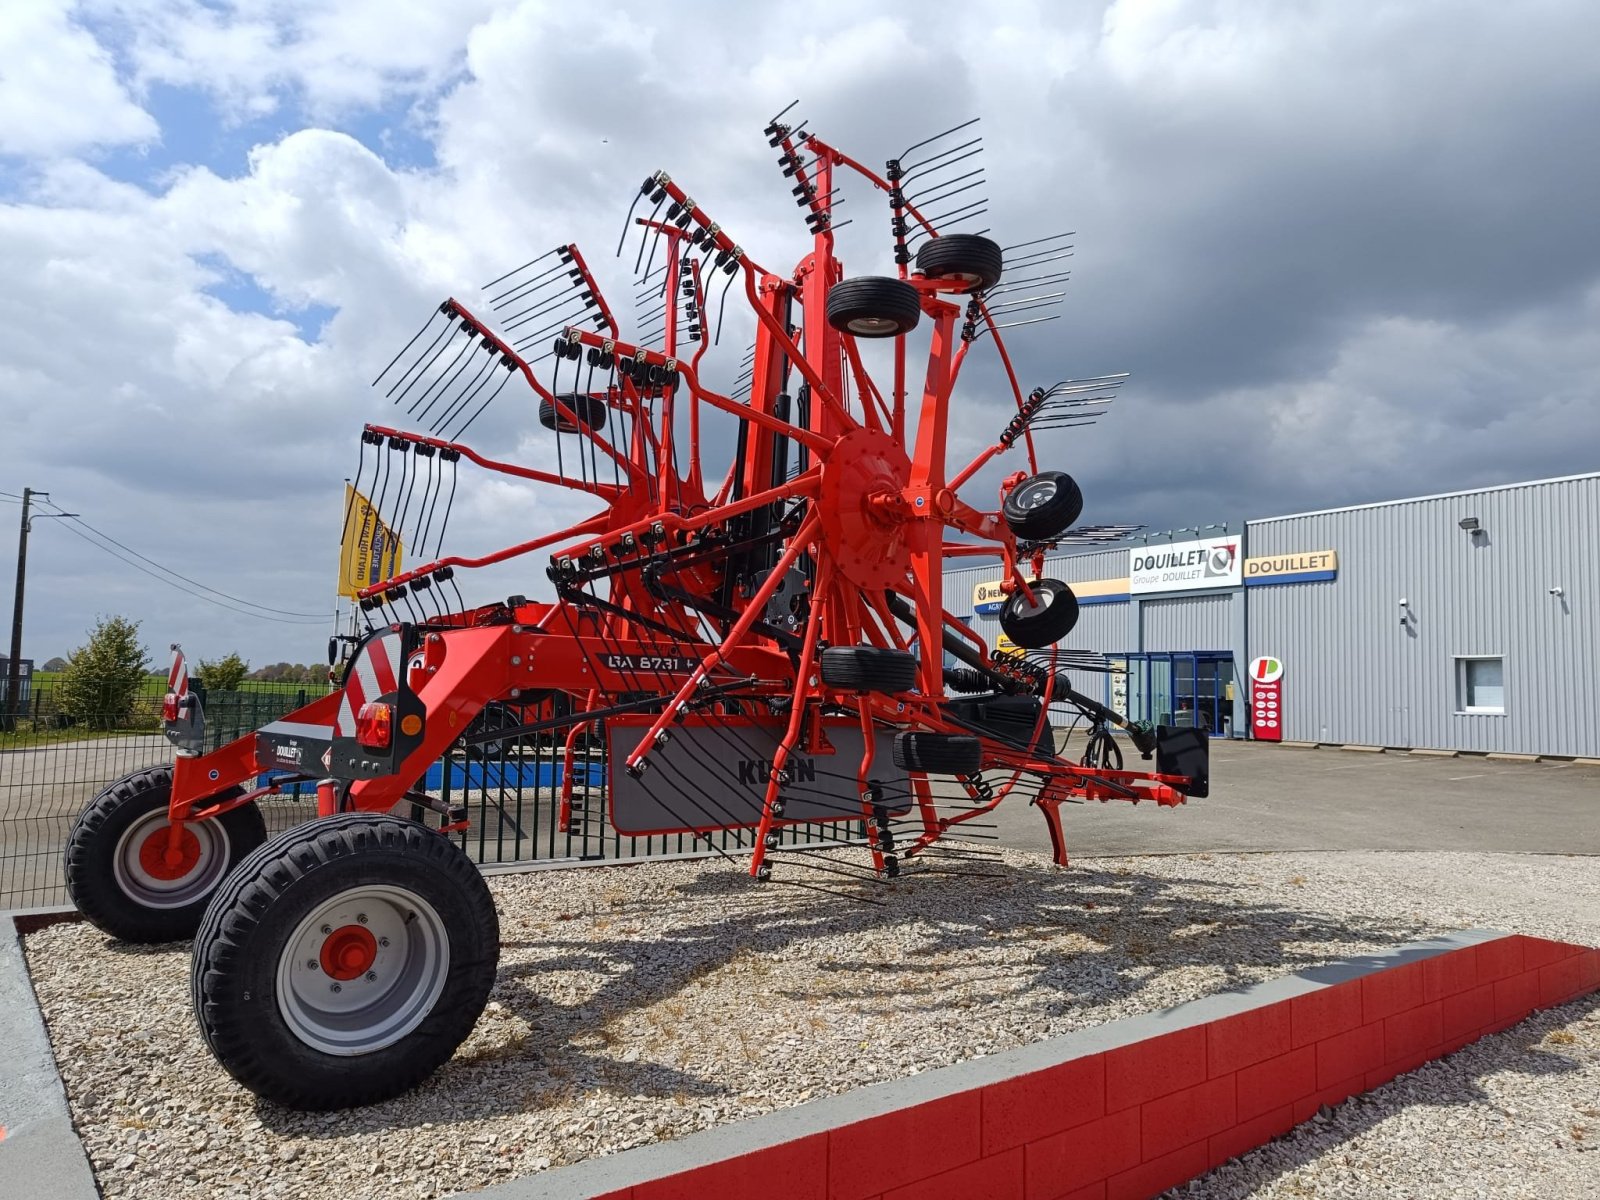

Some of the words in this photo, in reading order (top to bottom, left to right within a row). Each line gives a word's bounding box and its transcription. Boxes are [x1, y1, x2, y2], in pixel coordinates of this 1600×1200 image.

[1133, 549, 1206, 572] DOUILLET
[1249, 554, 1330, 574] DOUILLET
[1133, 573, 1160, 585] Groupe
[1162, 569, 1202, 582] DOUILLET
[640, 657, 678, 670] 8731
